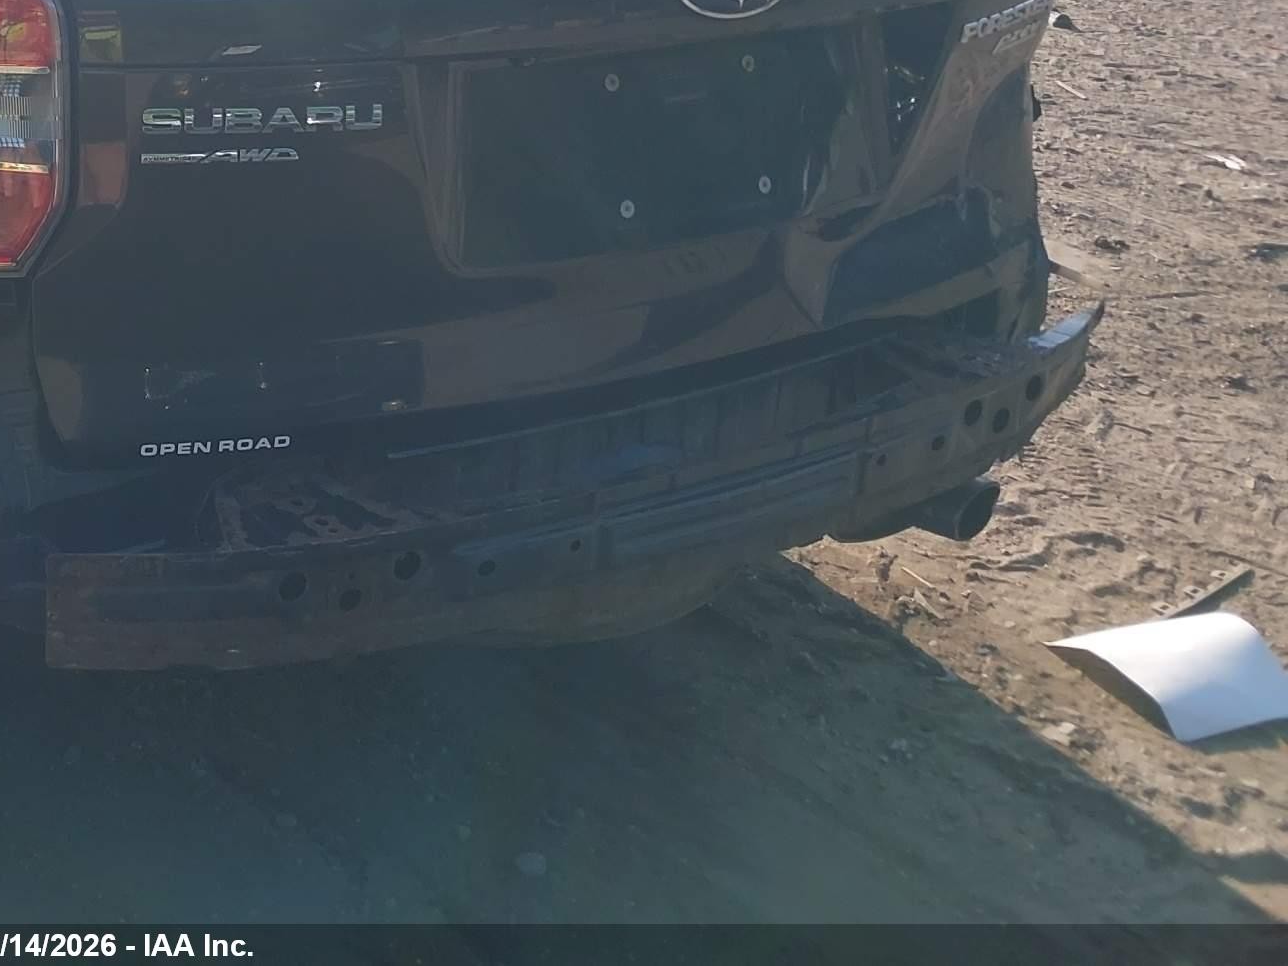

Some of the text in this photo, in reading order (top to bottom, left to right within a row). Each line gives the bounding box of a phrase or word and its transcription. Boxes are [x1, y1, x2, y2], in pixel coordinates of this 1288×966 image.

[142, 104, 383, 134] SUBARU
[199, 147, 299, 164] AWD
[140, 436, 291, 456] OPEN ROAD
